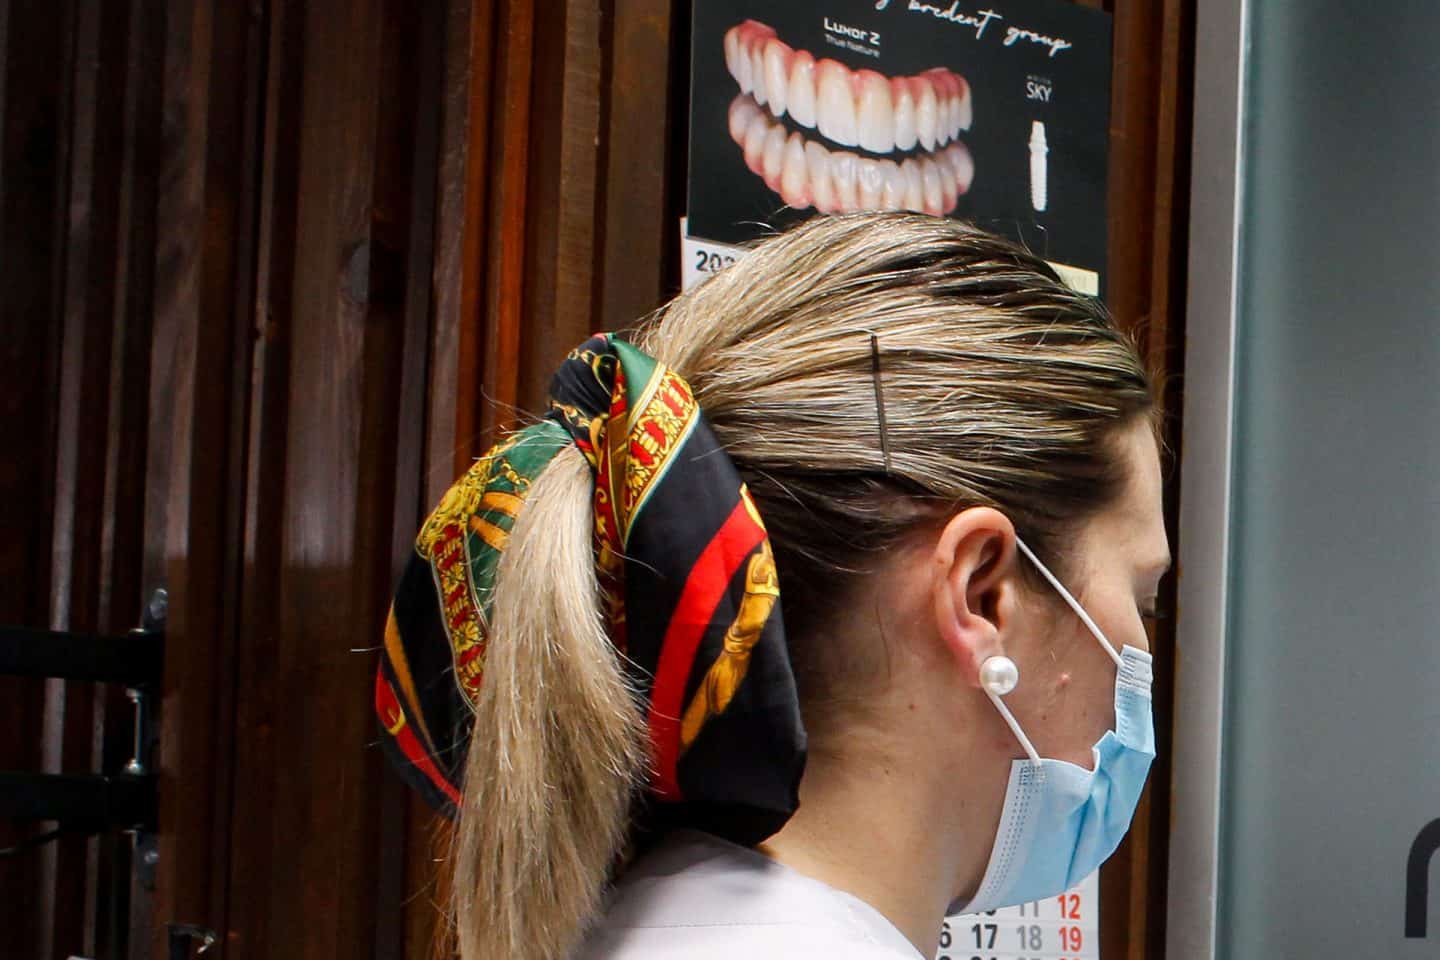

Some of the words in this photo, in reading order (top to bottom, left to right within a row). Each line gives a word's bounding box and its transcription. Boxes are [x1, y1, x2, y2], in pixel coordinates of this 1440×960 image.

[869, 31, 881, 46] Z
[1003, 26, 1072, 57] group
[1026, 81, 1053, 102] SKY
[1057, 894, 1081, 919] 12
[971, 923, 998, 949] 17
[1016, 925, 1042, 951] 18
[1058, 927, 1082, 952] 19
